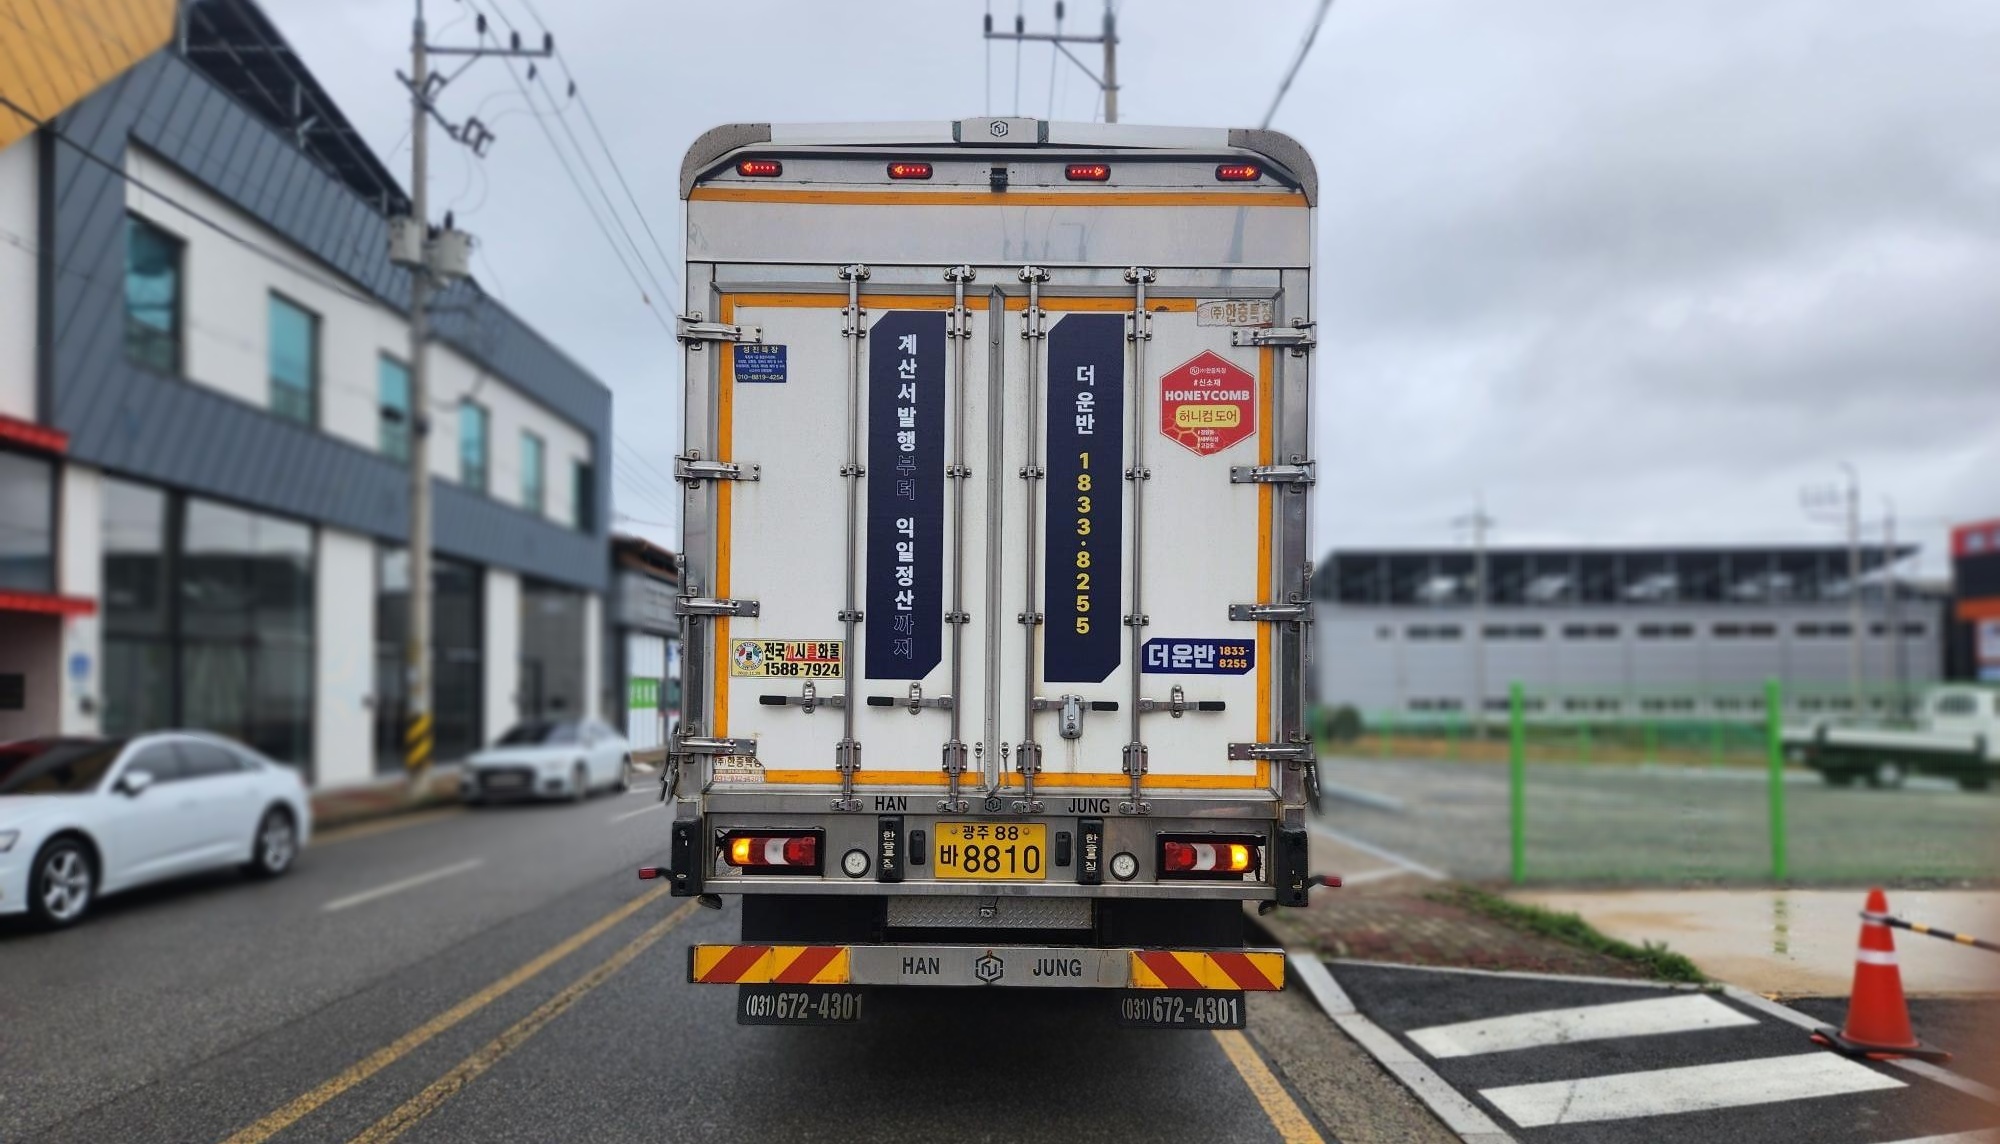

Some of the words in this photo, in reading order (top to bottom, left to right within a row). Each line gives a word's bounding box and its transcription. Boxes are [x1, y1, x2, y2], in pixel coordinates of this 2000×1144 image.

[1165, 390, 1250, 401] HONEYCOMB
[896, 333, 917, 501] 계산서발행부터
[1179, 409, 1213, 423] 허니컴
[1214, 410, 1237, 422] 도어
[894, 517, 915, 660] 익일정산까지
[1148, 644, 1216, 669] 더운반
[1219, 646, 1250, 656] 1833-
[764, 662, 840, 676] 1588-7924
[1219, 659, 1248, 668] 8255
[875, 796, 907, 811] HAN
[1068, 798, 1110, 813] JUNG
[962, 825, 989, 840] 광주
[994, 825, 1019, 840] 88
[902, 957, 940, 975] HAN
[1032, 958, 1082, 977] JUNG
